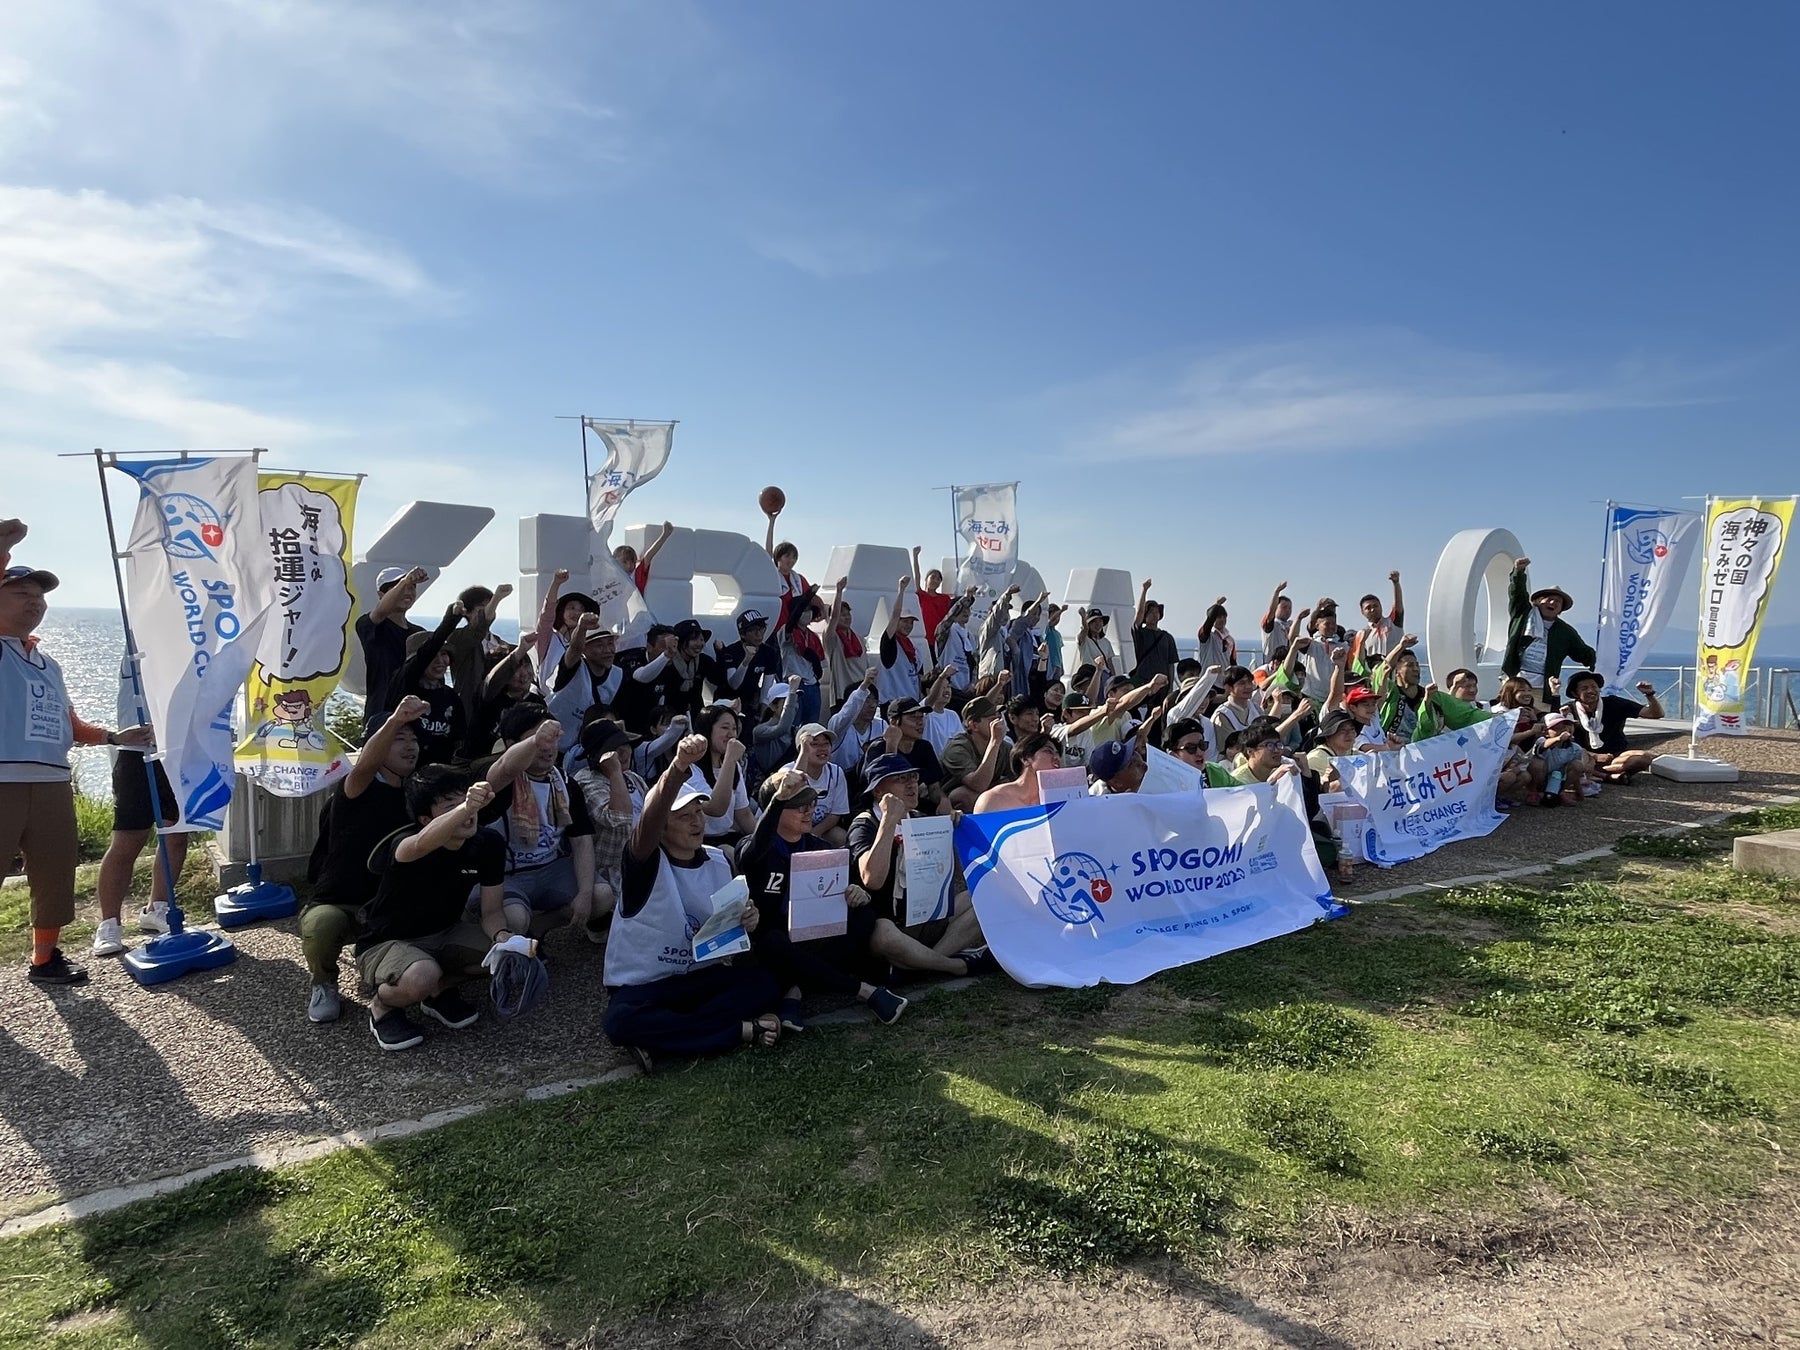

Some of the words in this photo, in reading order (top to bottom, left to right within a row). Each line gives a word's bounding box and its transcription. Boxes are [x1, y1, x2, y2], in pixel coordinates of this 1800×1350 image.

[967, 519, 1010, 535] 海ごみ
[977, 535, 1002, 551] ゼロ
[1730, 517, 1768, 585] 神々の国
[1622, 572, 1640, 619] WORLD
[172, 570, 207, 646] WORLD
[273, 765, 319, 776] CHANGE
[1422, 800, 1468, 823] CHANGE
[1131, 842, 1244, 877] SPOGOMI
[764, 872, 785, 893] 12
[1186, 876, 1214, 894] CUP
